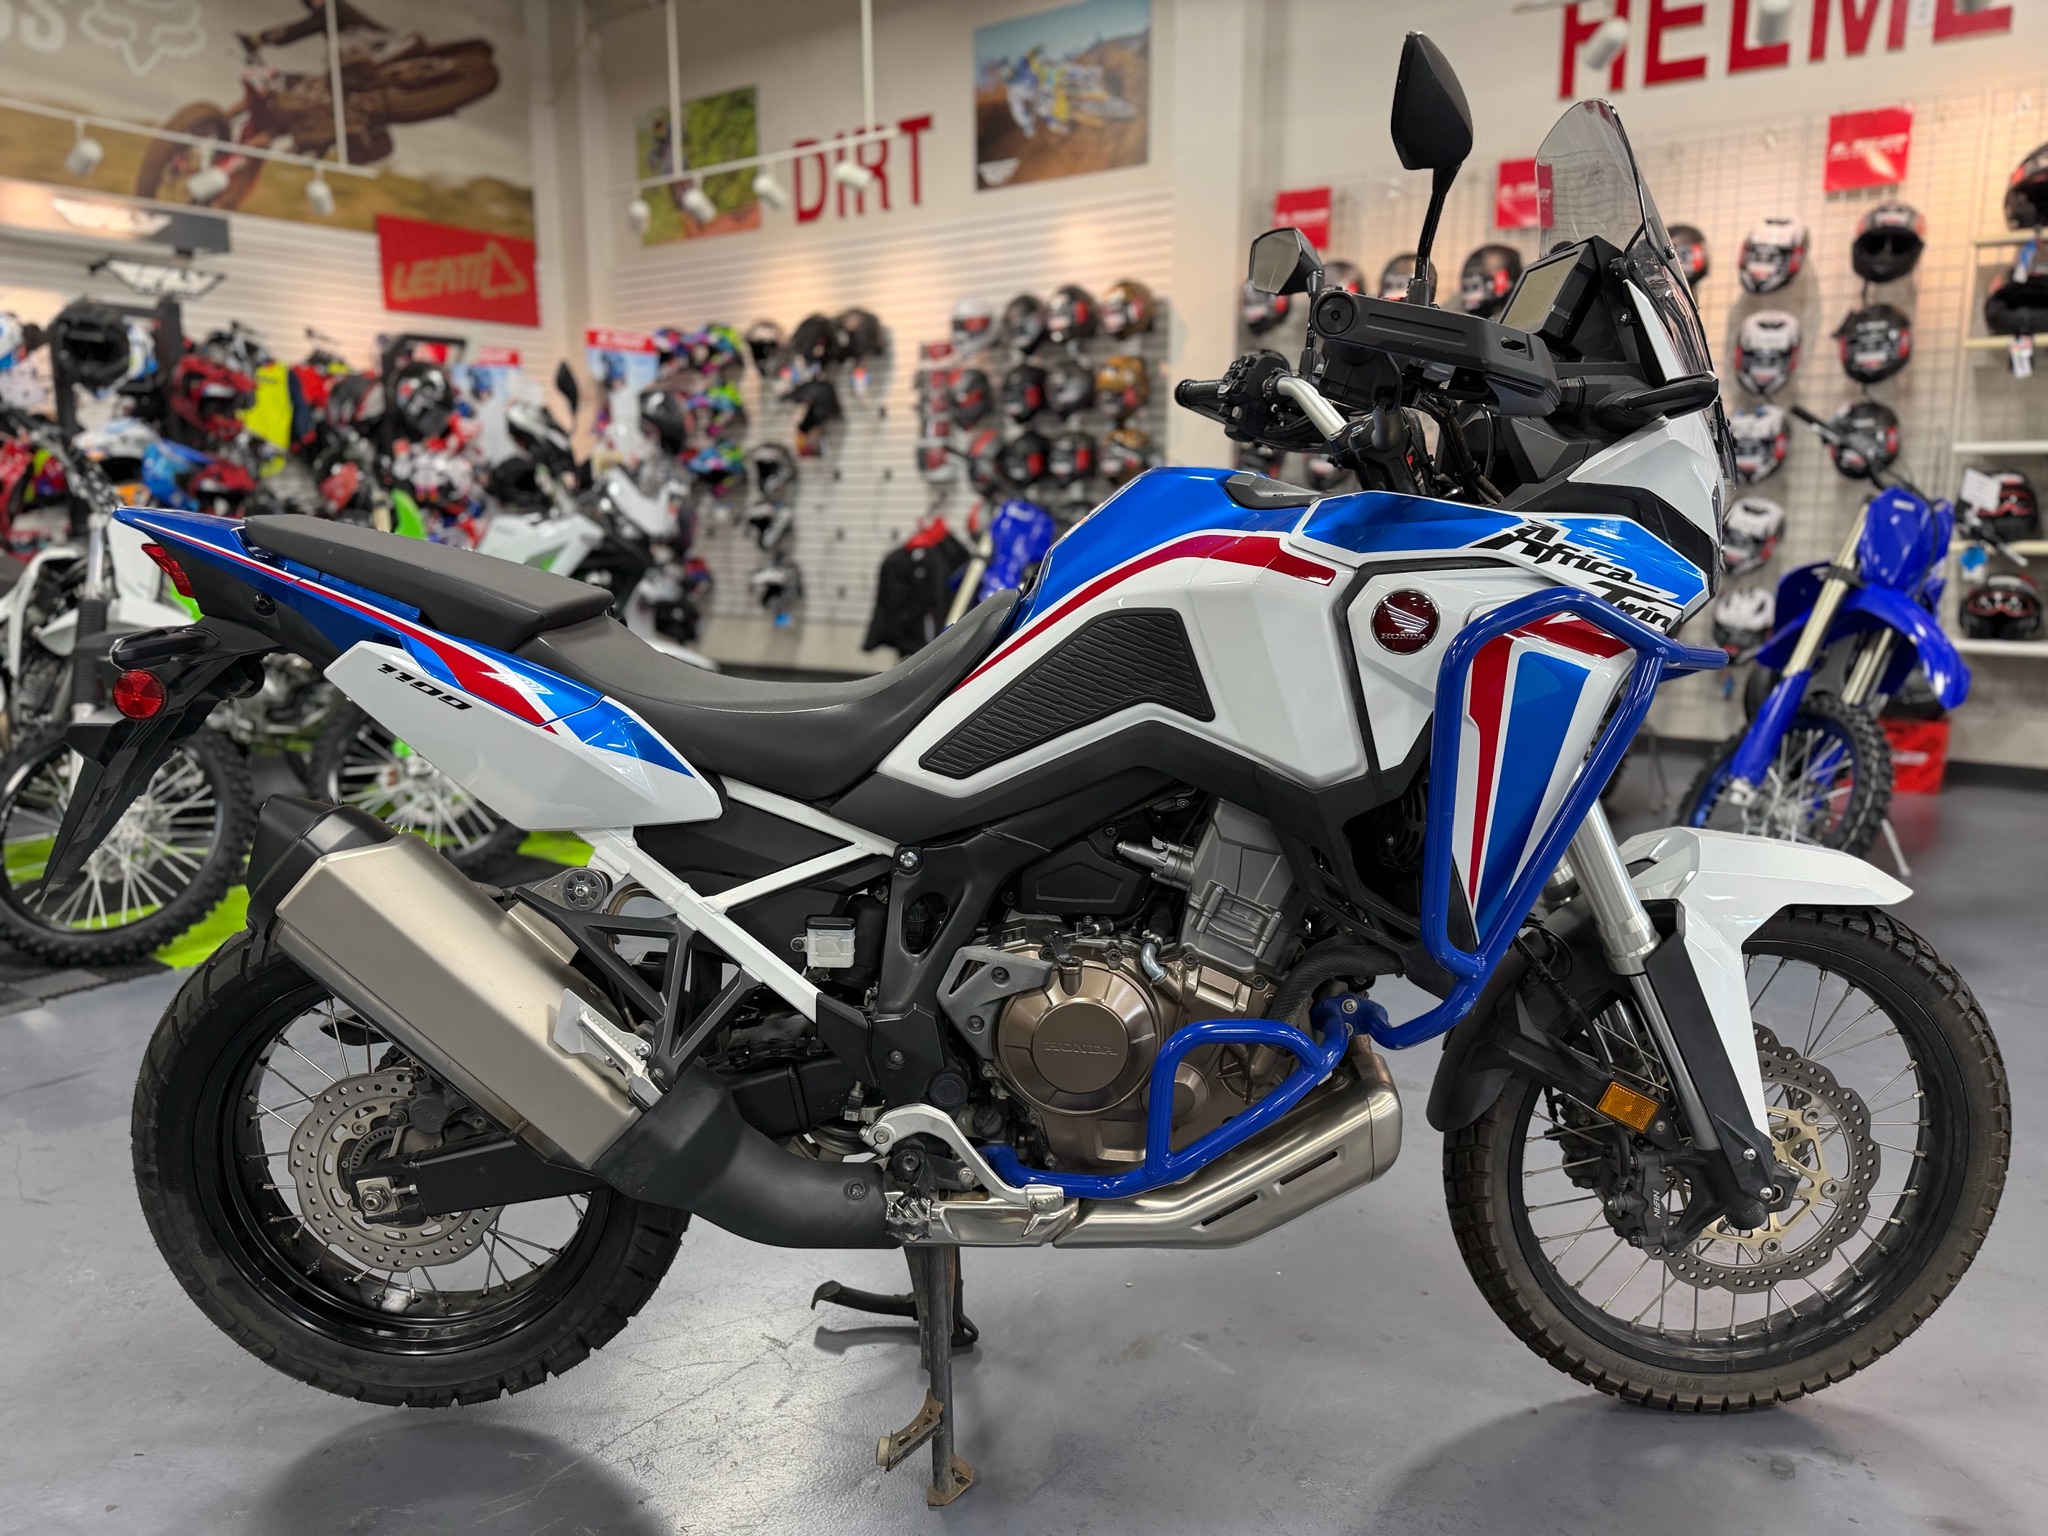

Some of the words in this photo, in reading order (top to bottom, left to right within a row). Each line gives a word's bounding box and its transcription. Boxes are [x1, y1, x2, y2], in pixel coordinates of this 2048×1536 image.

[793, 113, 932, 224] DIRT
[1468, 519, 1645, 584] Africa
[1588, 581, 1683, 628] Twin
[1380, 632, 1428, 640] HONDA
[377, 663, 473, 711] 1100
[1044, 1041, 1118, 1056] HONDA
[1652, 1189, 1661, 1219] NISSIN
